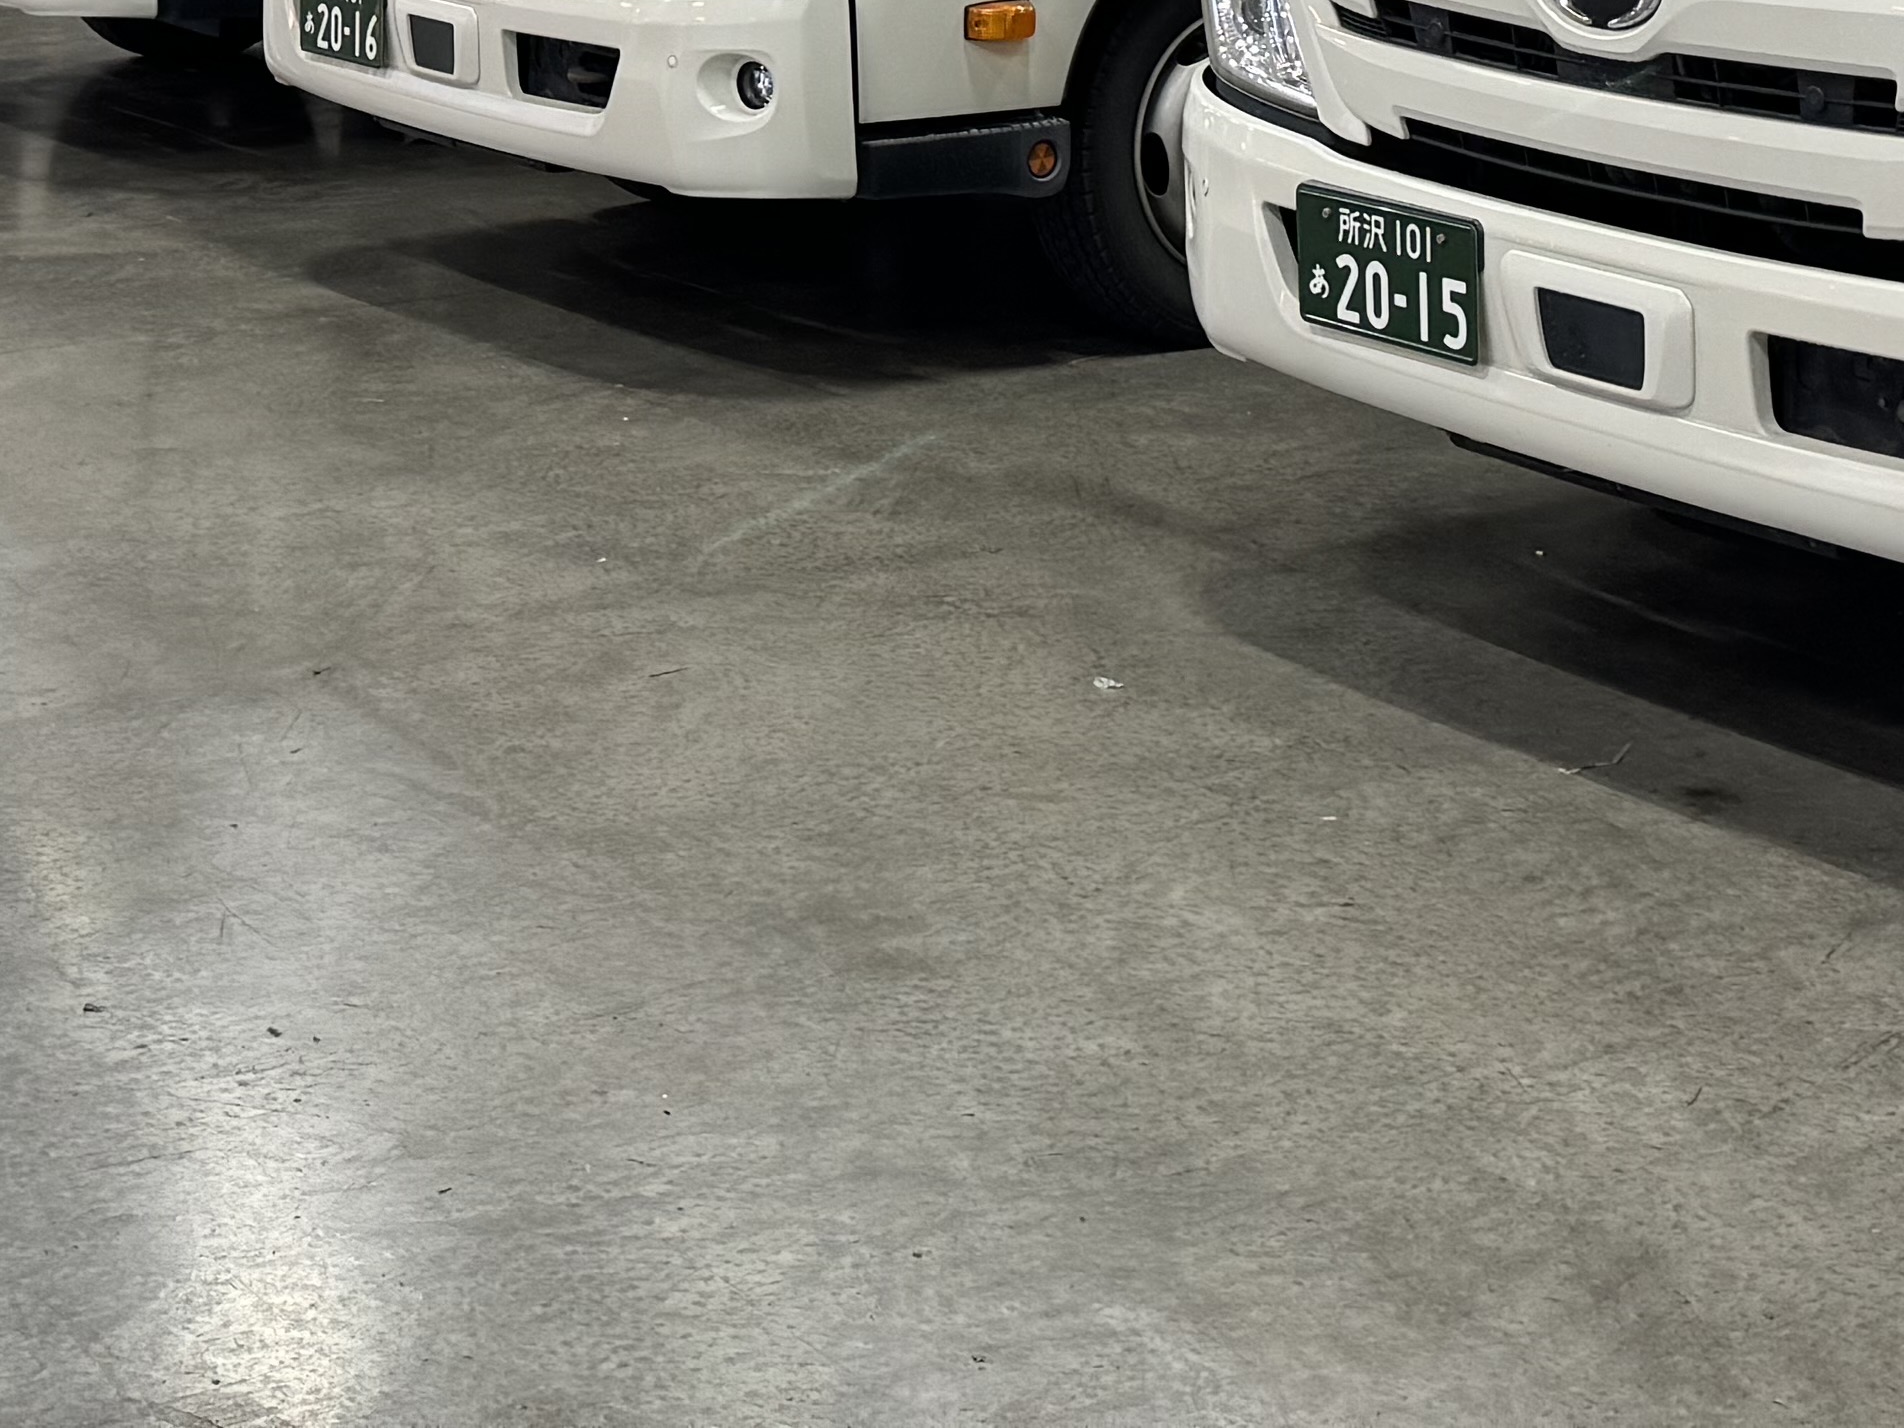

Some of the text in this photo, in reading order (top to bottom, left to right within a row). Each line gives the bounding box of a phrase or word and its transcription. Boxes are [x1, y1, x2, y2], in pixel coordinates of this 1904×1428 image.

[304, 2, 378, 61] あ 20-16
[1338, 207, 1432, 263] 所沢 101
[1308, 252, 1468, 351] あ 20-15
